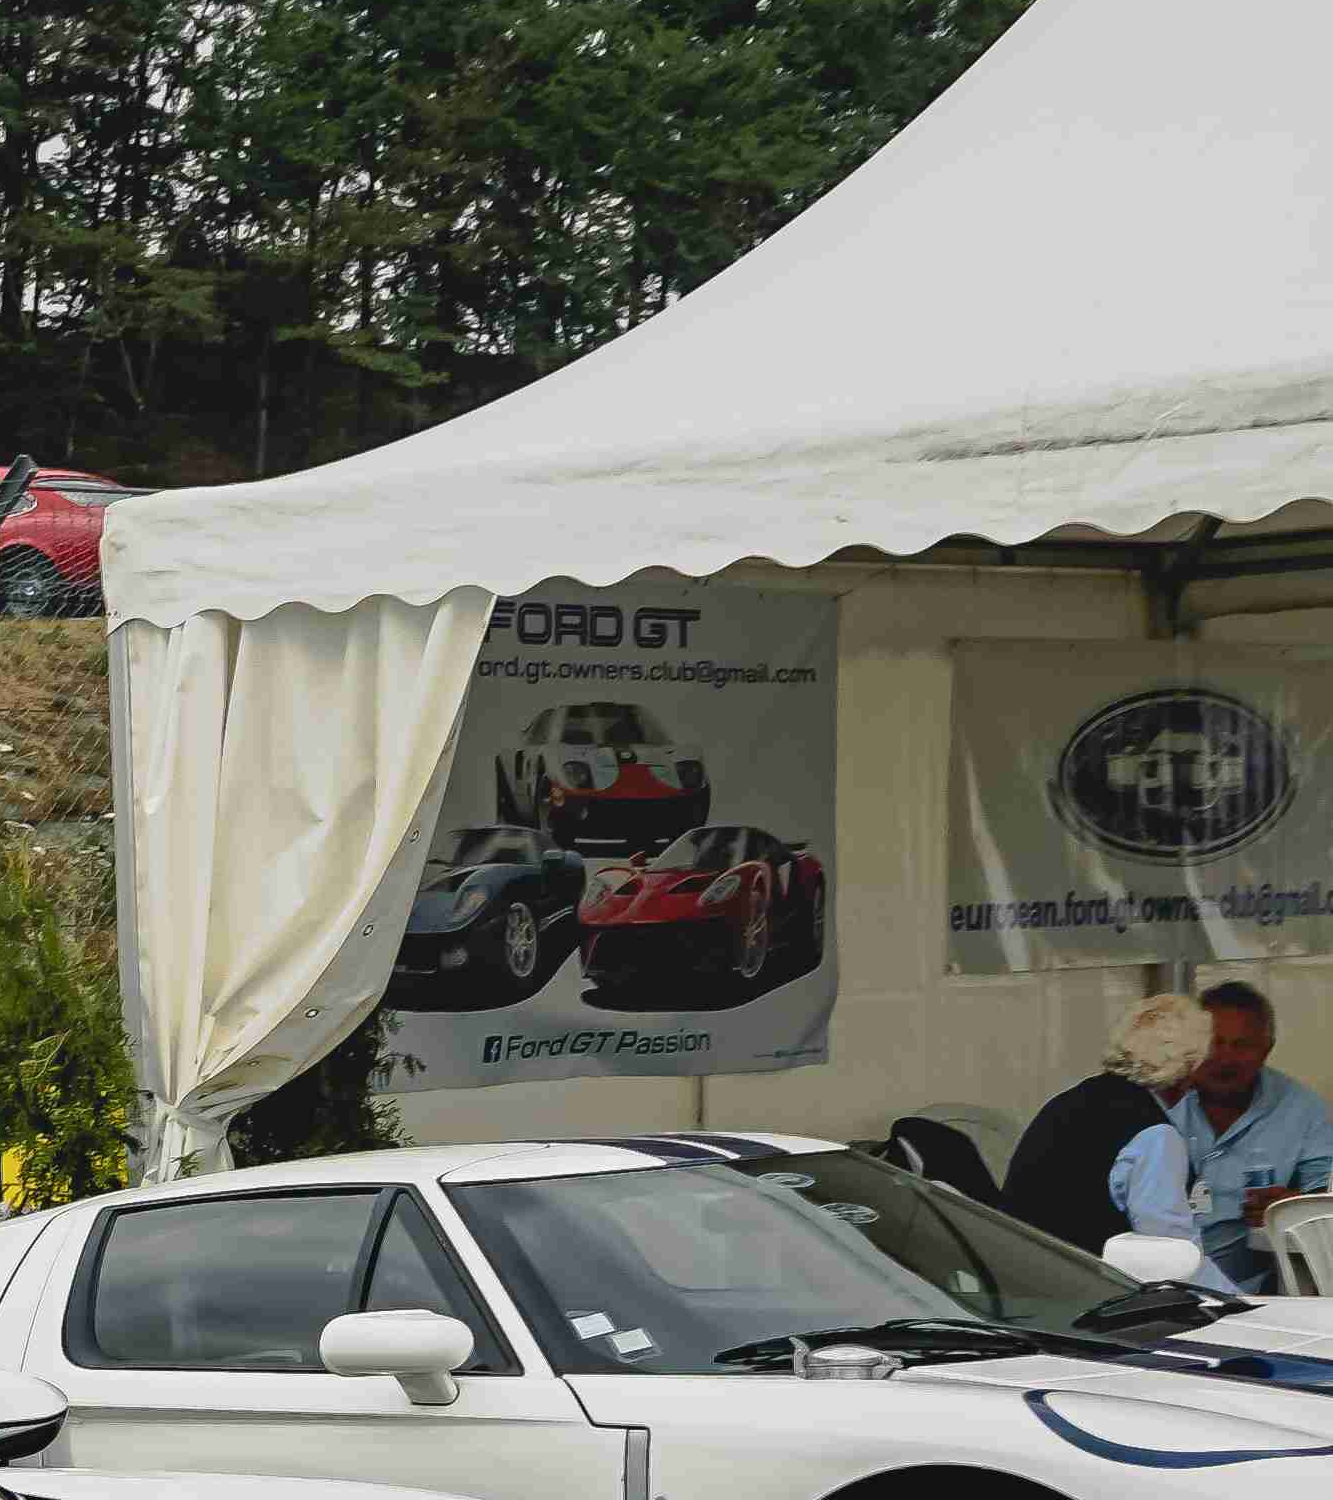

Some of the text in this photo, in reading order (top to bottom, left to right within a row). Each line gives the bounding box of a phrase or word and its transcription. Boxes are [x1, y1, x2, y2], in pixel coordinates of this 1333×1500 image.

[485, 600, 701, 649] FORD GT
[477, 656, 817, 689] ord.gt.owners.club@gmail.com
[505, 1034, 570, 1061] Ford
[570, 1030, 614, 1054] GT
[615, 1028, 710, 1056] Passion
